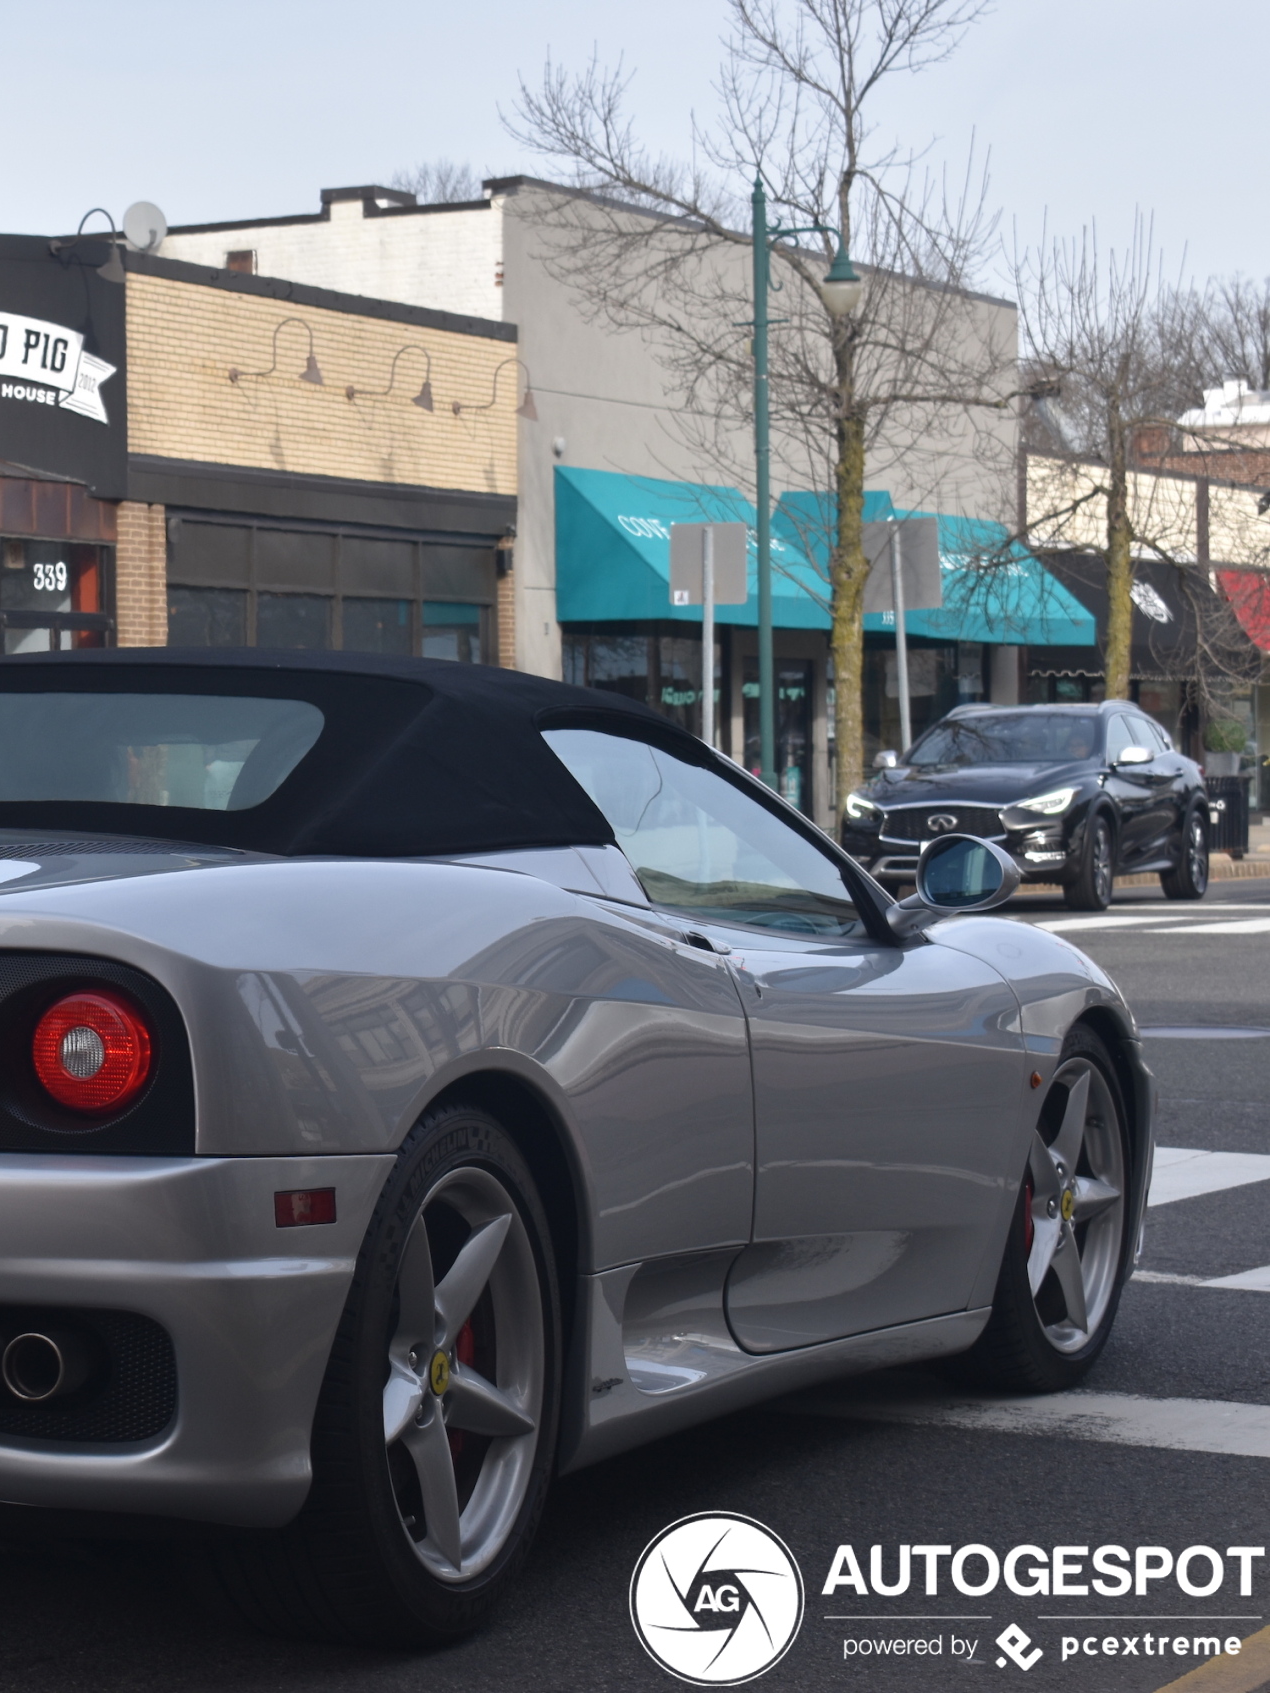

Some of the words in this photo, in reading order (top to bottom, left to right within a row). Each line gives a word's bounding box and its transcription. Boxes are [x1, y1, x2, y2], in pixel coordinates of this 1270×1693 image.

[21, 328, 68, 373] PIG
[1, 383, 56, 405] HOUSE
[33, 561, 67, 591] 339
[410, 1126, 469, 1196] MICHELIN
